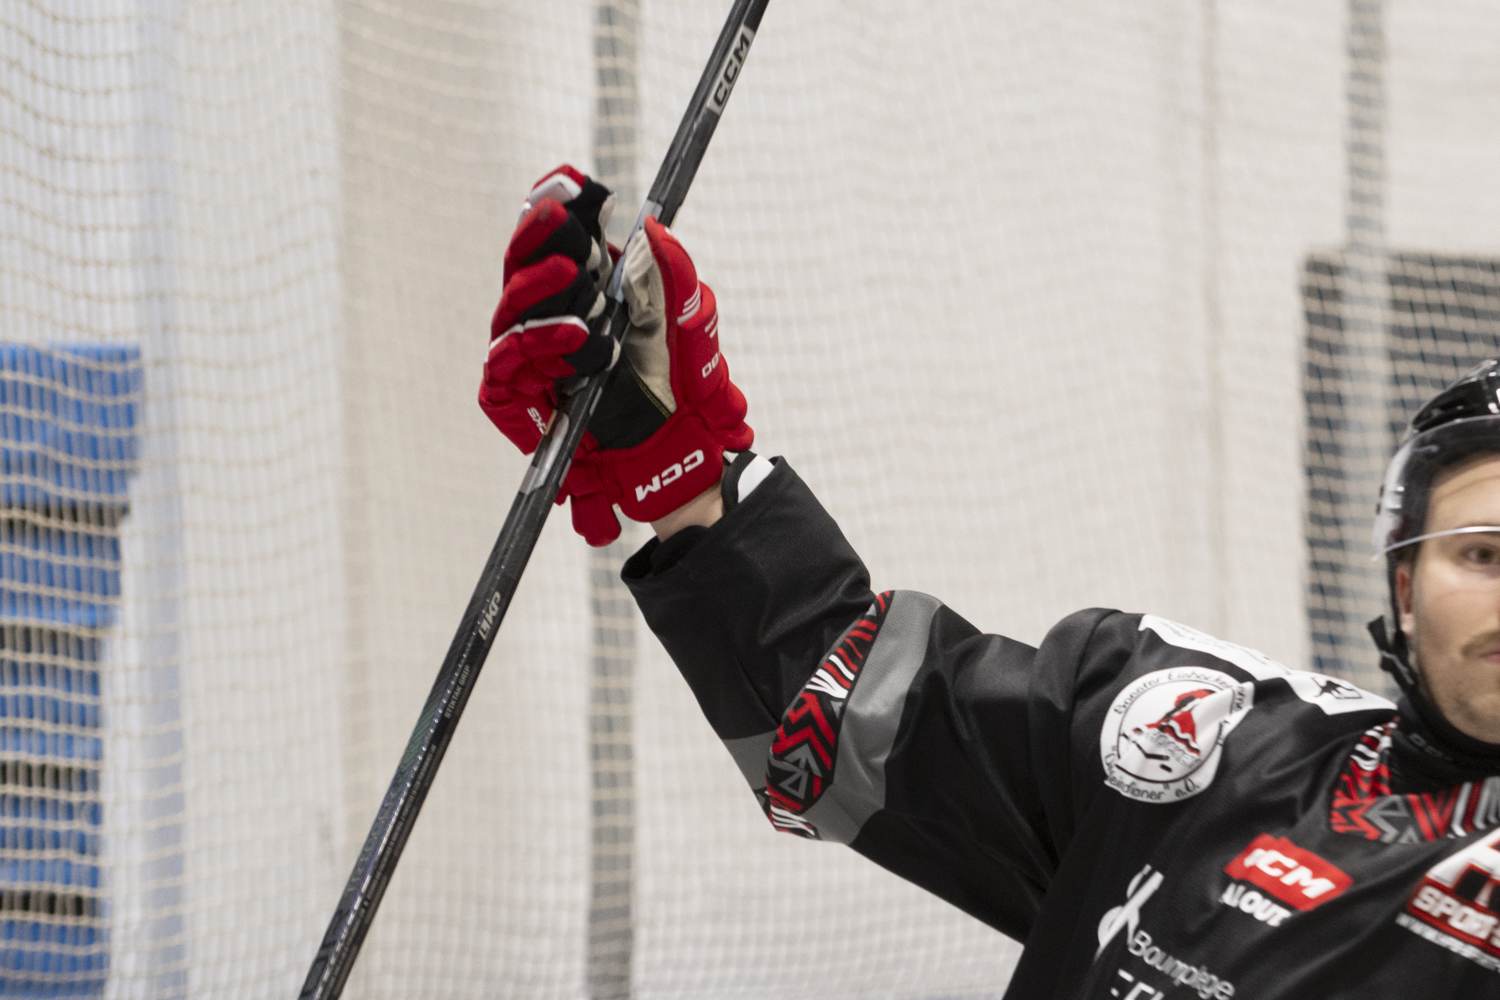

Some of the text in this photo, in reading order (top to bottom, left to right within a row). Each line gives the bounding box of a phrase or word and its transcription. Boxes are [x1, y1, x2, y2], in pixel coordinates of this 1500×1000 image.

[713, 32, 750, 107] CCM
[635, 449, 705, 502] CCM
[457, 664, 471, 685] GRIP
